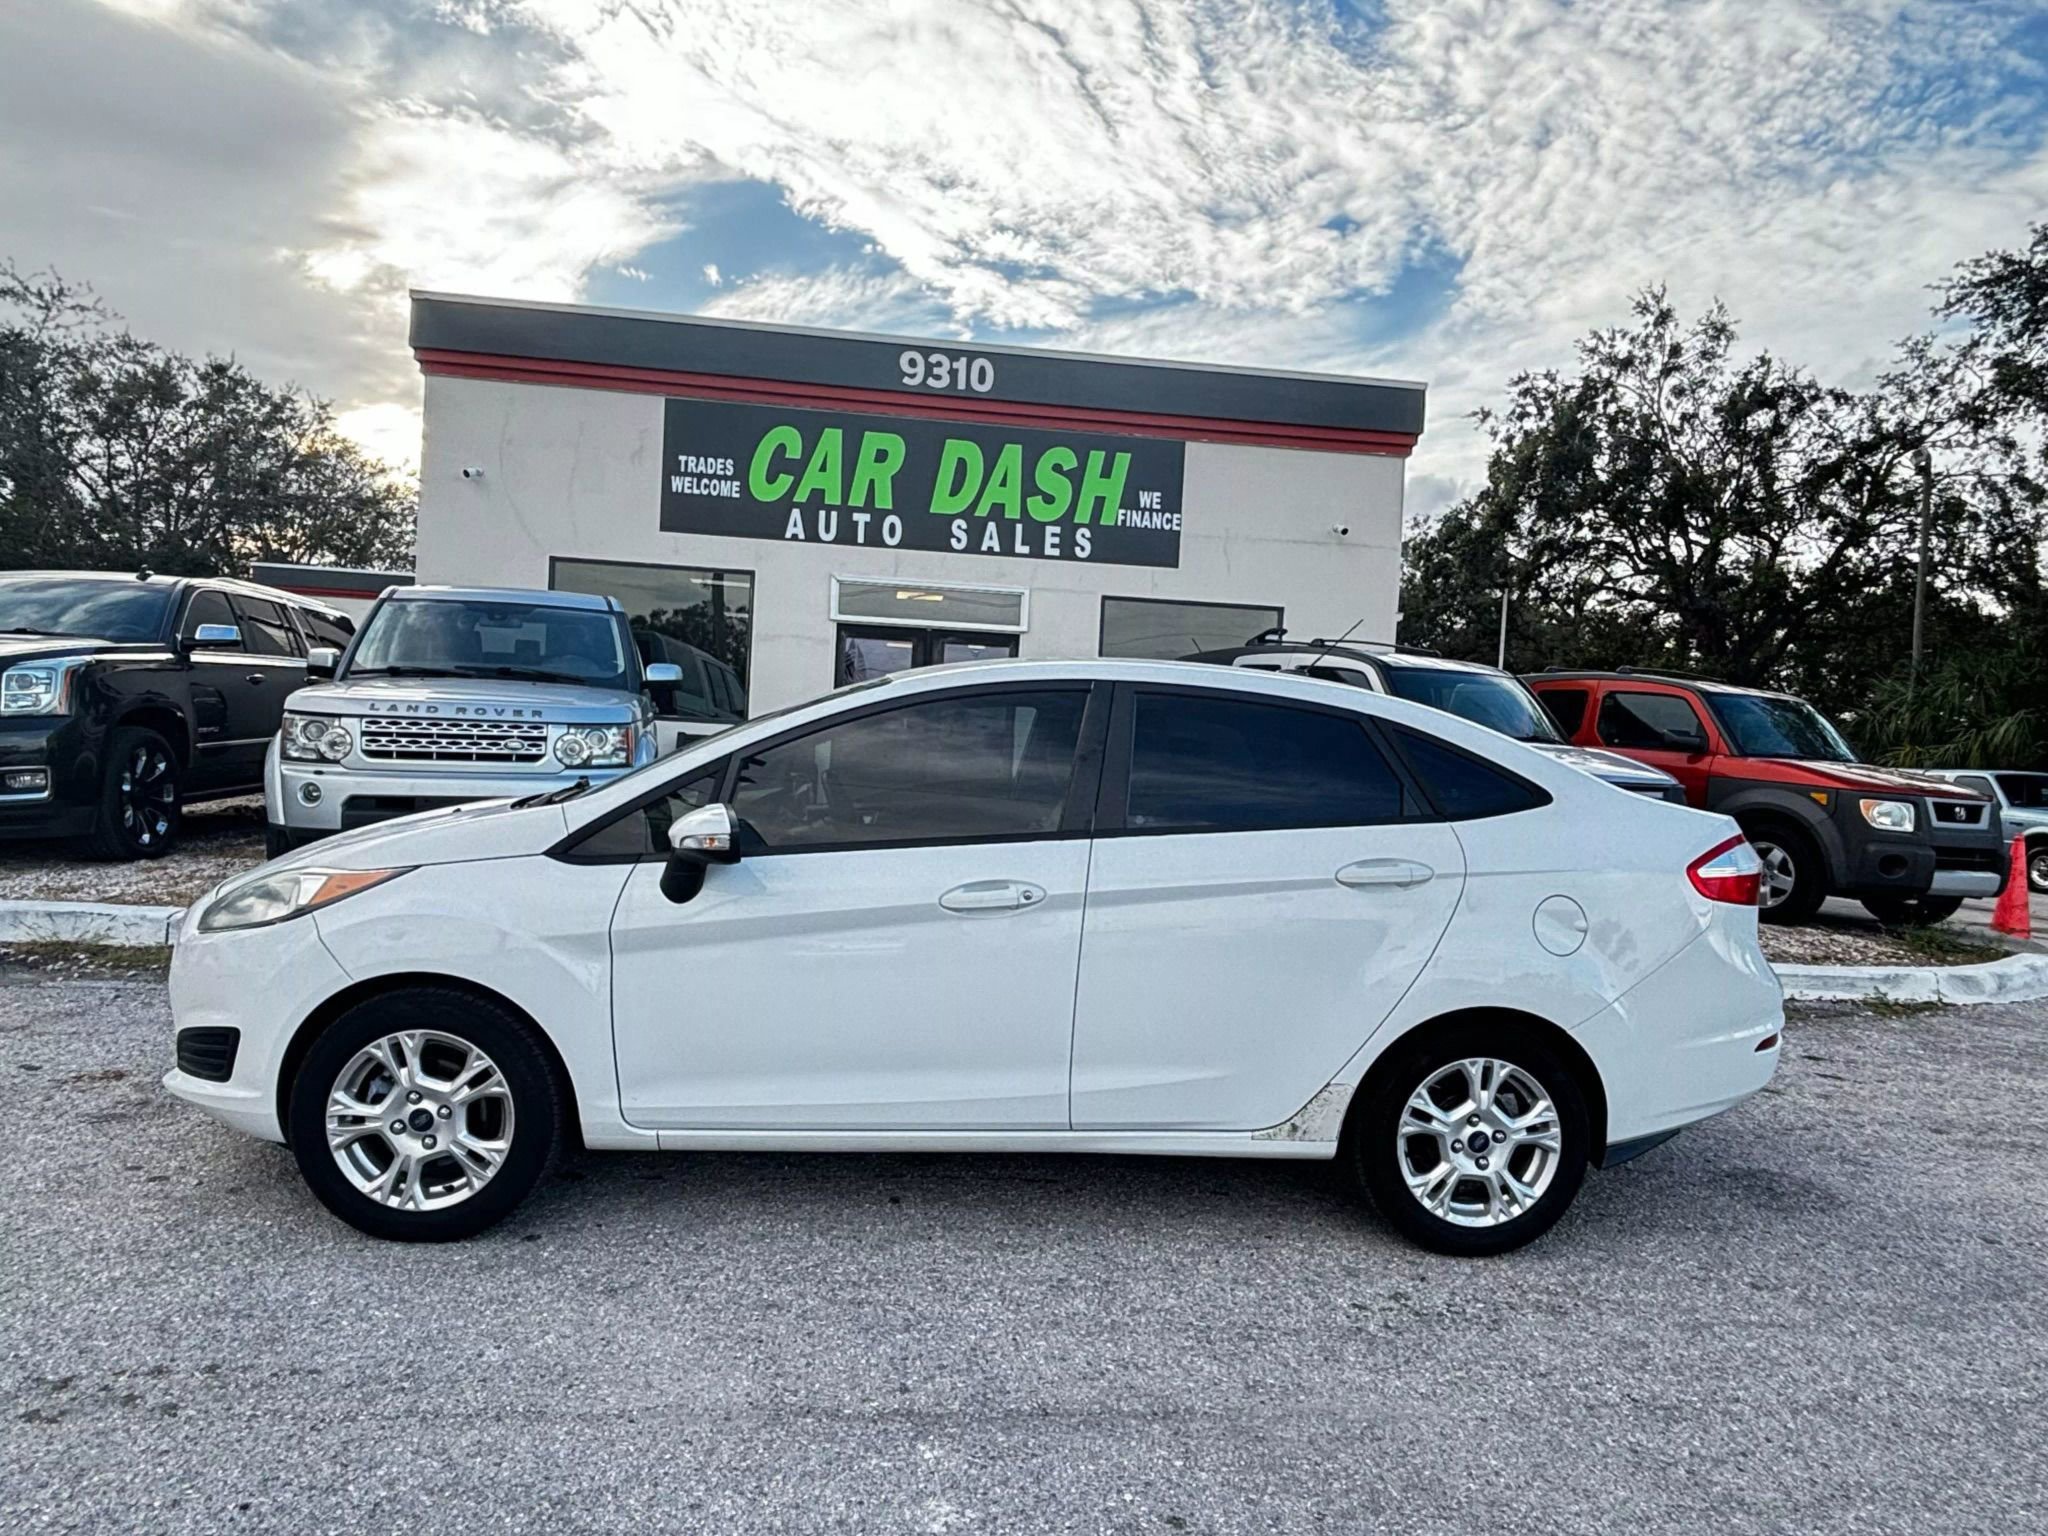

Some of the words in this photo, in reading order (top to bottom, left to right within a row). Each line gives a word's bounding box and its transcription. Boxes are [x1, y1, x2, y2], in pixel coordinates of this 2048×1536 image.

[899, 350, 995, 393] 9310
[678, 455, 735, 475] TRADES
[748, 425, 906, 510] CAR
[929, 438, 1131, 526] DASH
[670, 476, 741, 499] WELCOME
[1138, 490, 1162, 509] WE
[1117, 509, 1182, 532] FINANCE
[784, 508, 903, 546] AUTO
[950, 518, 1093, 559] SALES
[368, 702, 439, 714] LAND
[455, 706, 543, 719] ROVER
